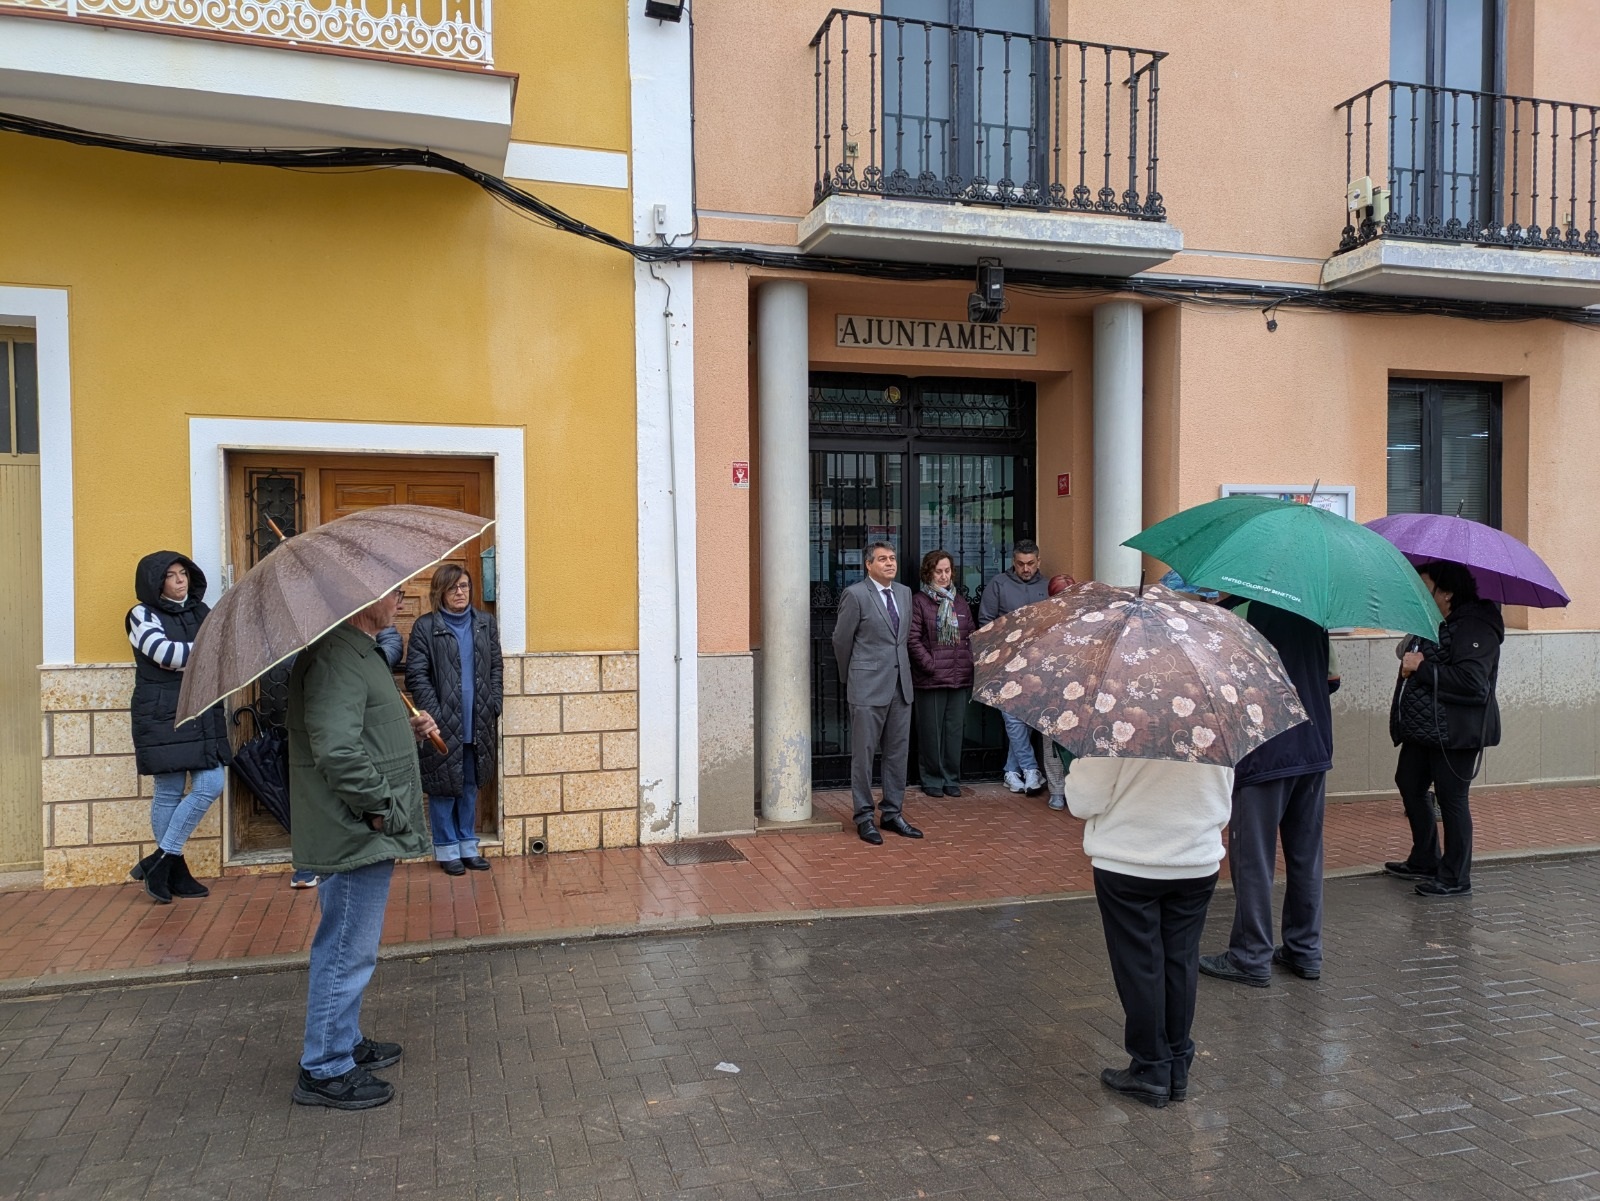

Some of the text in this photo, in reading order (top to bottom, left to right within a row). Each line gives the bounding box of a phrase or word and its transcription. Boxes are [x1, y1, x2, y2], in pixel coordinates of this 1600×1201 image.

[840, 318, 1035, 352] AJUNTAMENT
[1221, 576, 1242, 585] UNITED
[1242, 581, 1263, 590] COLORS
